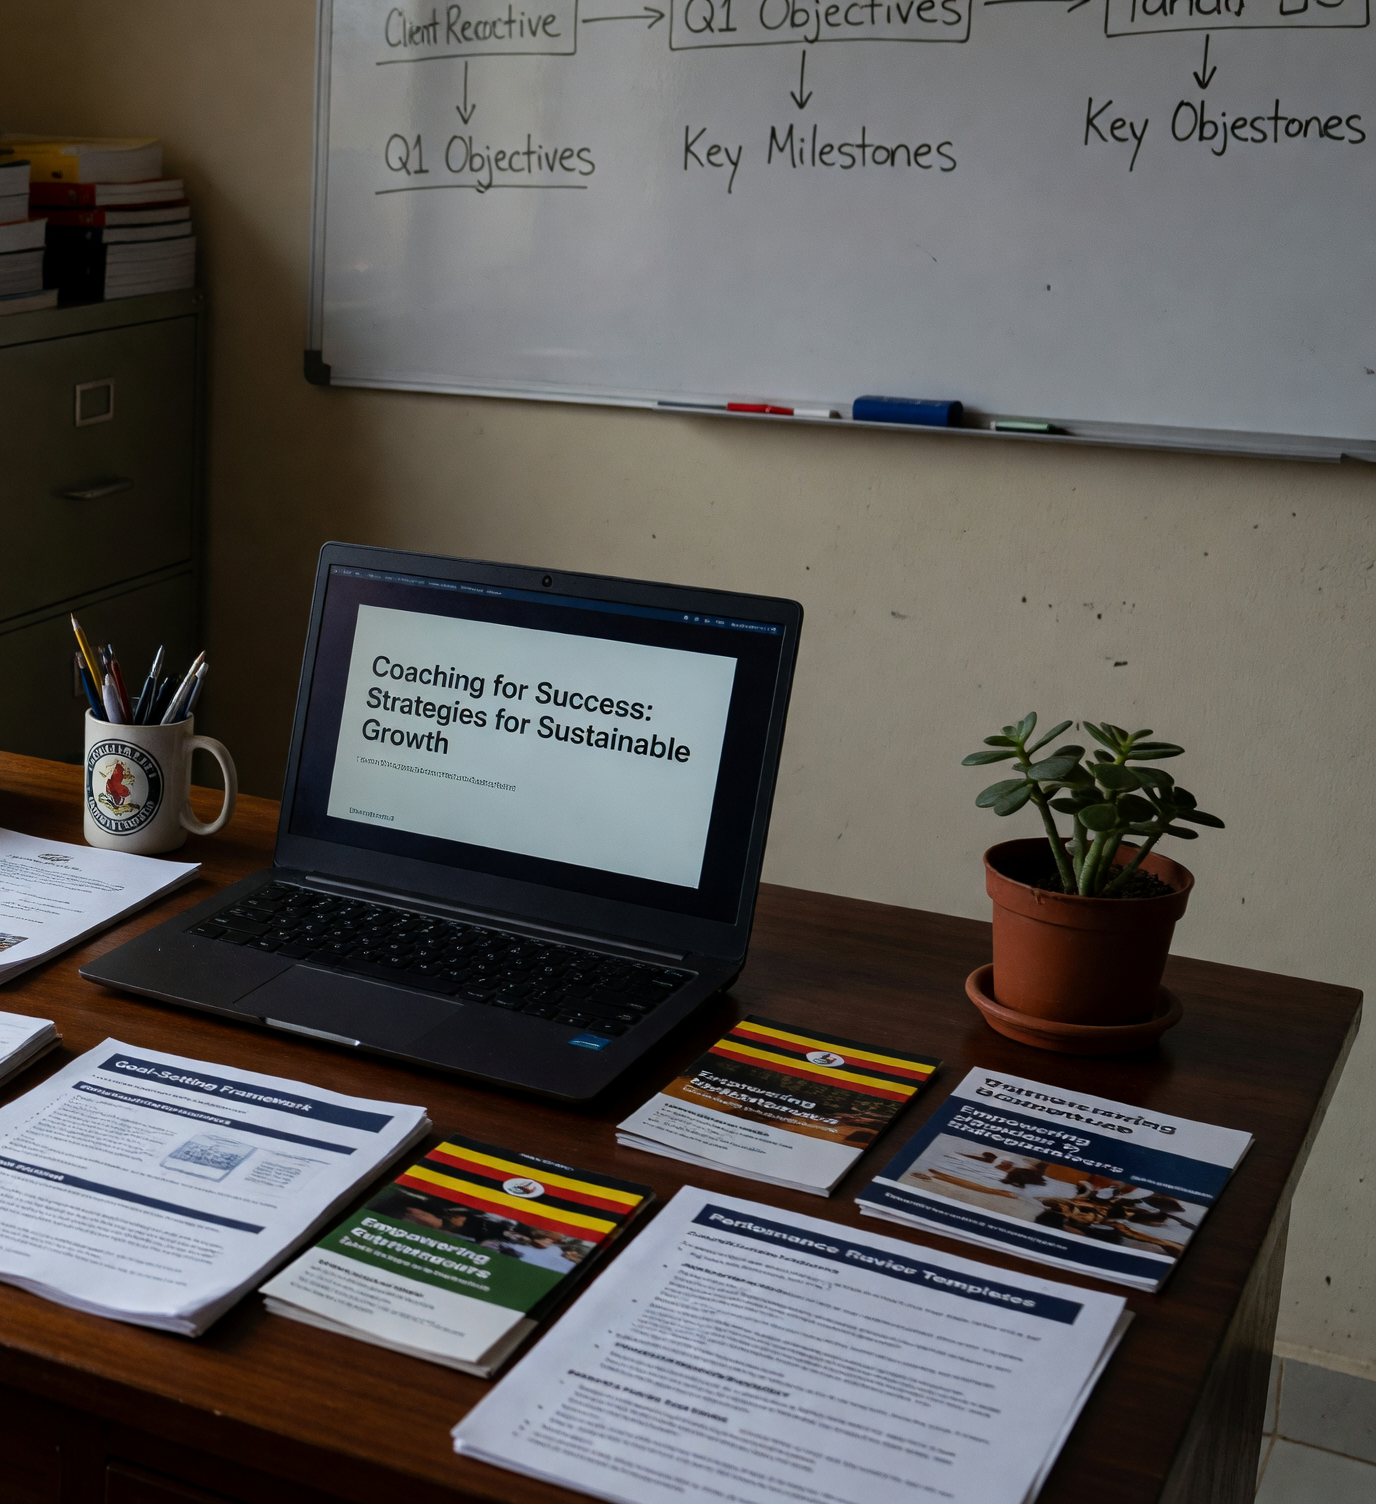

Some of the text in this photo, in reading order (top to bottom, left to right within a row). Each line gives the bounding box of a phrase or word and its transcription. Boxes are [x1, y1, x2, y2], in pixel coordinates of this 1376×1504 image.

[384, 133, 596, 193] Q1 Objectives
[684, 123, 957, 194] Key Milestones
[1084, 97, 1149, 172] Key
[372, 655, 653, 722] Coaching for Success:
[362, 718, 449, 755] Growth
[366, 686, 691, 763] Strategies for Sustainable
